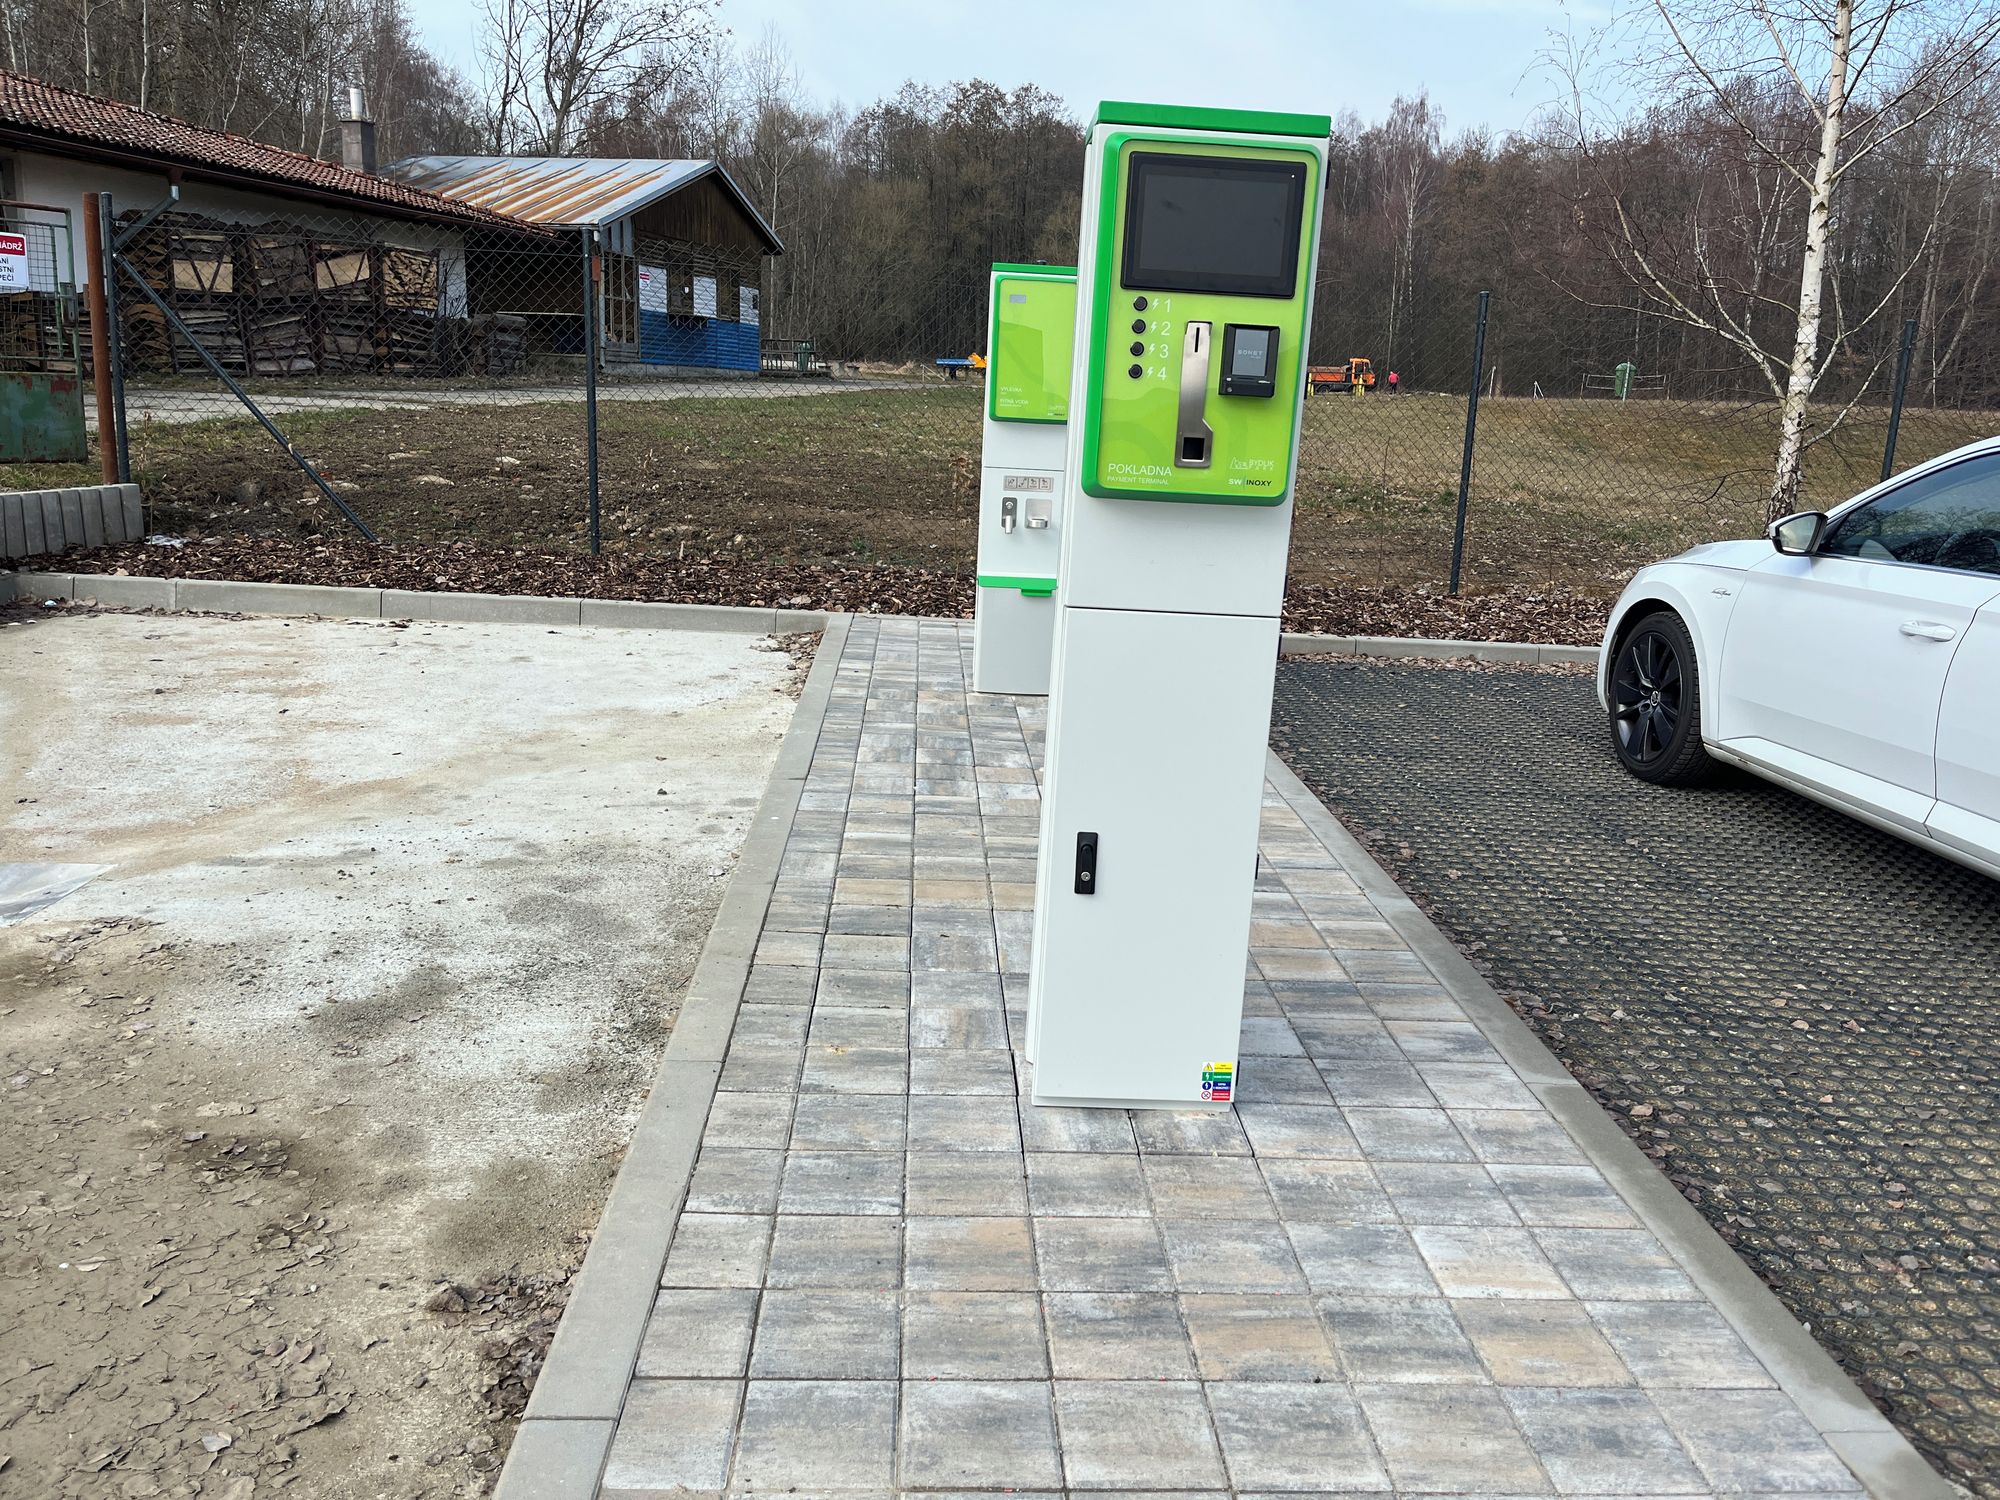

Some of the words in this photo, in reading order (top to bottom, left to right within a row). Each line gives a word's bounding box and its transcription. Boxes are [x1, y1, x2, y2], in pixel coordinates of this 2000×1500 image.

[0, 240, 23, 251] ÁDRŽ
[1164, 298, 1171, 313] 1
[1160, 321, 1171, 336] 2
[1159, 343, 1169, 359] 3
[1157, 366, 1167, 381] 4
[1108, 463, 1172, 476] POKLADNA
[1138, 478, 1168, 486] TERMINAL
[1246, 479, 1272, 487] INOXY
